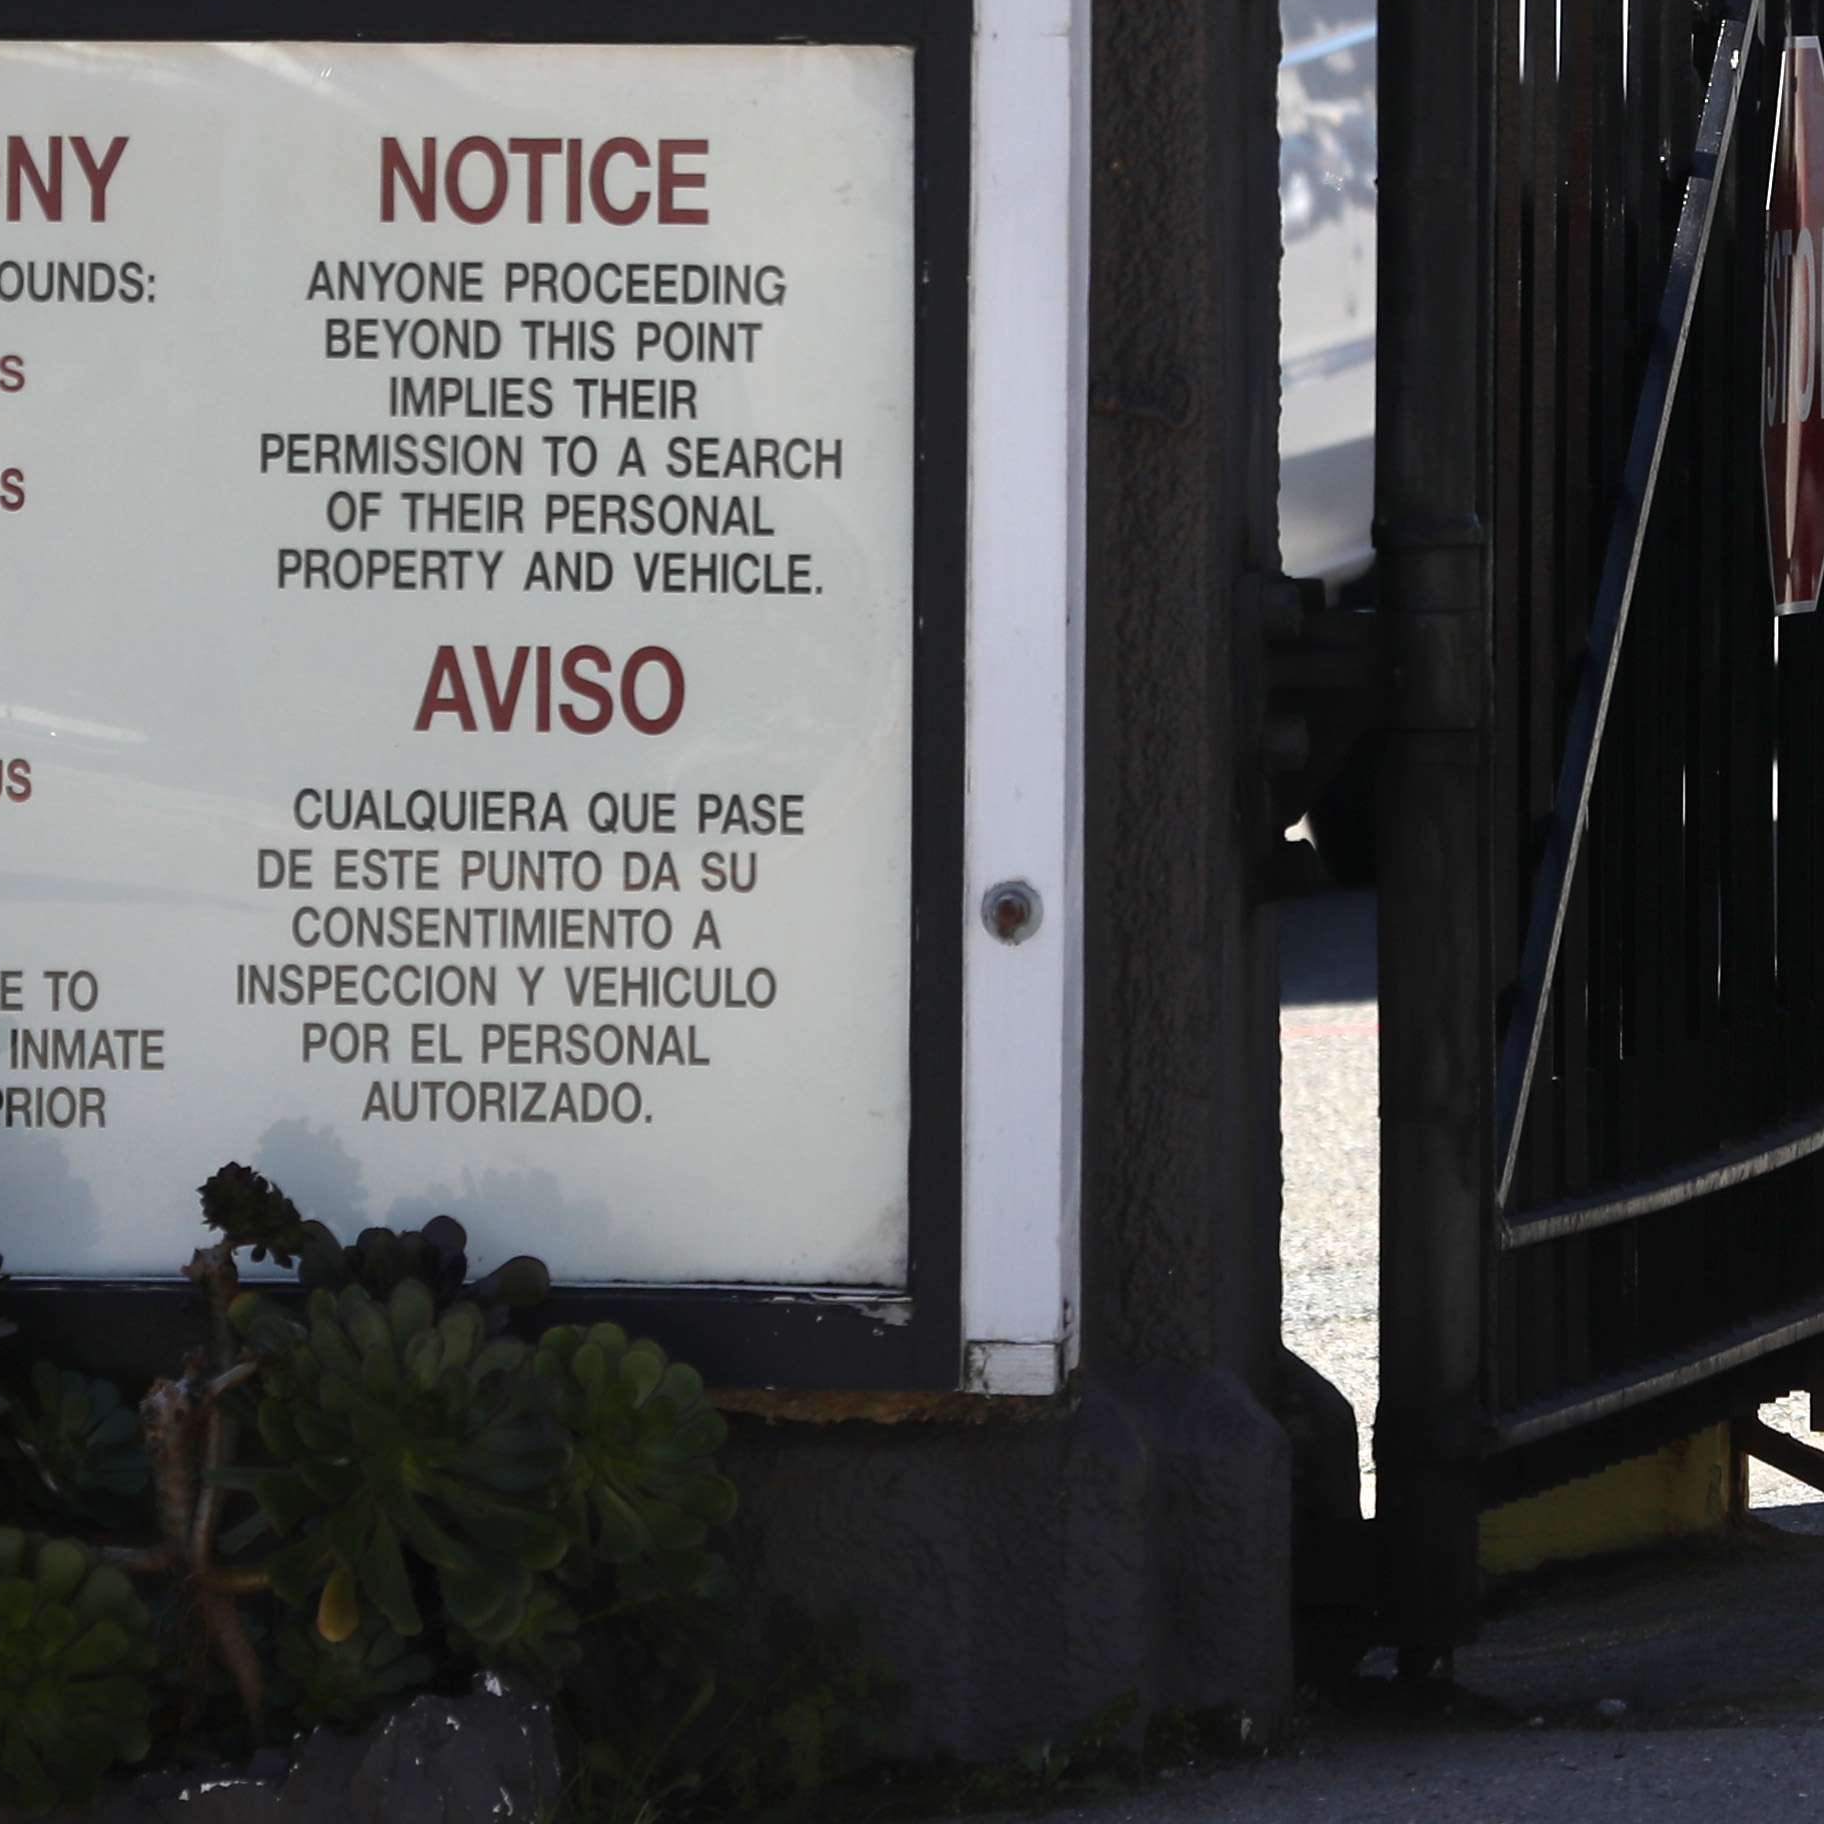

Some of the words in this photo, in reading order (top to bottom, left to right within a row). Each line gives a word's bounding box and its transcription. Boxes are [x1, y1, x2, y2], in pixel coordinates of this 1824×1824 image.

[381, 136, 708, 225] NOTICE
[307, 261, 483, 303] ANYONE
[506, 262, 786, 305] PROCEEDING
[326, 319, 501, 359] BEYOND
[521, 320, 615, 361] THIS
[637, 321, 762, 362] POINT
[391, 377, 553, 418] IMPLIES
[573, 378, 696, 419] THEIR
[261, 433, 522, 476] PERMISSION
[543, 436, 597, 477] TO
[618, 437, 646, 476] A
[667, 436, 841, 479] SEARCH
[327, 491, 381, 532] OF
[401, 492, 523, 533] THEIR
[546, 494, 774, 536] PERSONAL
[279, 549, 503, 590] PROPERTY
[524, 551, 613, 591] AND
[634, 552, 822, 594] VEHICLE.
[415, 645, 685, 735] AVISO
[294, 788, 568, 832] CUALQUIERA
[589, 792, 676, 833] QUE
[699, 794, 804, 835] PASE
[258, 849, 312, 889] DE
[335, 849, 439, 890] ESTE
[462, 850, 602, 891] PUNTO
[624, 851, 680, 891] DA
[701, 851, 756, 893] SU
[293, 906, 672, 950] CONSENTIMIENTO
[693, 910, 721, 949] A
[44, 970, 98, 1012] TO
[238, 964, 496, 1006] INSPECCION
[518, 967, 544, 1006] Y
[565, 967, 776, 1008] VEHICULO
[11, 1029, 163, 1069] INMATE
[303, 1022, 389, 1063] POR
[412, 1023, 462, 1063] EL
[482, 1024, 710, 1065] PERSONAL
[362, 1081, 652, 1123] AUTORIZADO.
